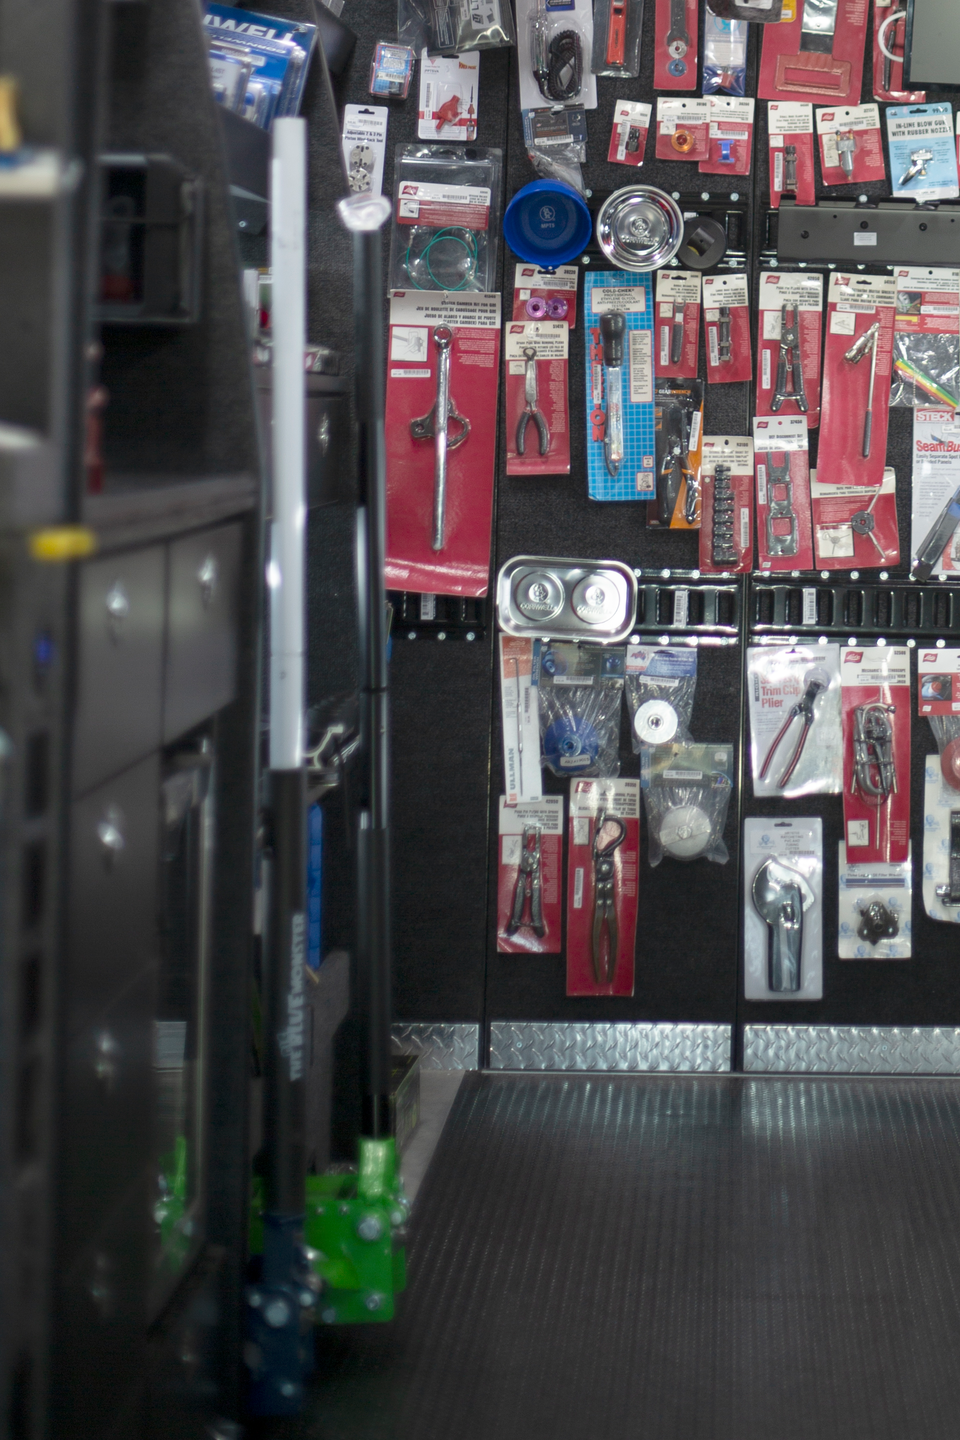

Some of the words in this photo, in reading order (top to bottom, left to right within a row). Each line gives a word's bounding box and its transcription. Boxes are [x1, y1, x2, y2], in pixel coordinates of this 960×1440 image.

[907, 128, 929, 136] RUBBER
[917, 412, 953, 421] STECK
[761, 686, 782, 696] Trim
[783, 685, 801, 696] Clip
[761, 698, 784, 708] Plier
[291, 914, 305, 994] MONSTER
[290, 1049, 302, 1081] THE
